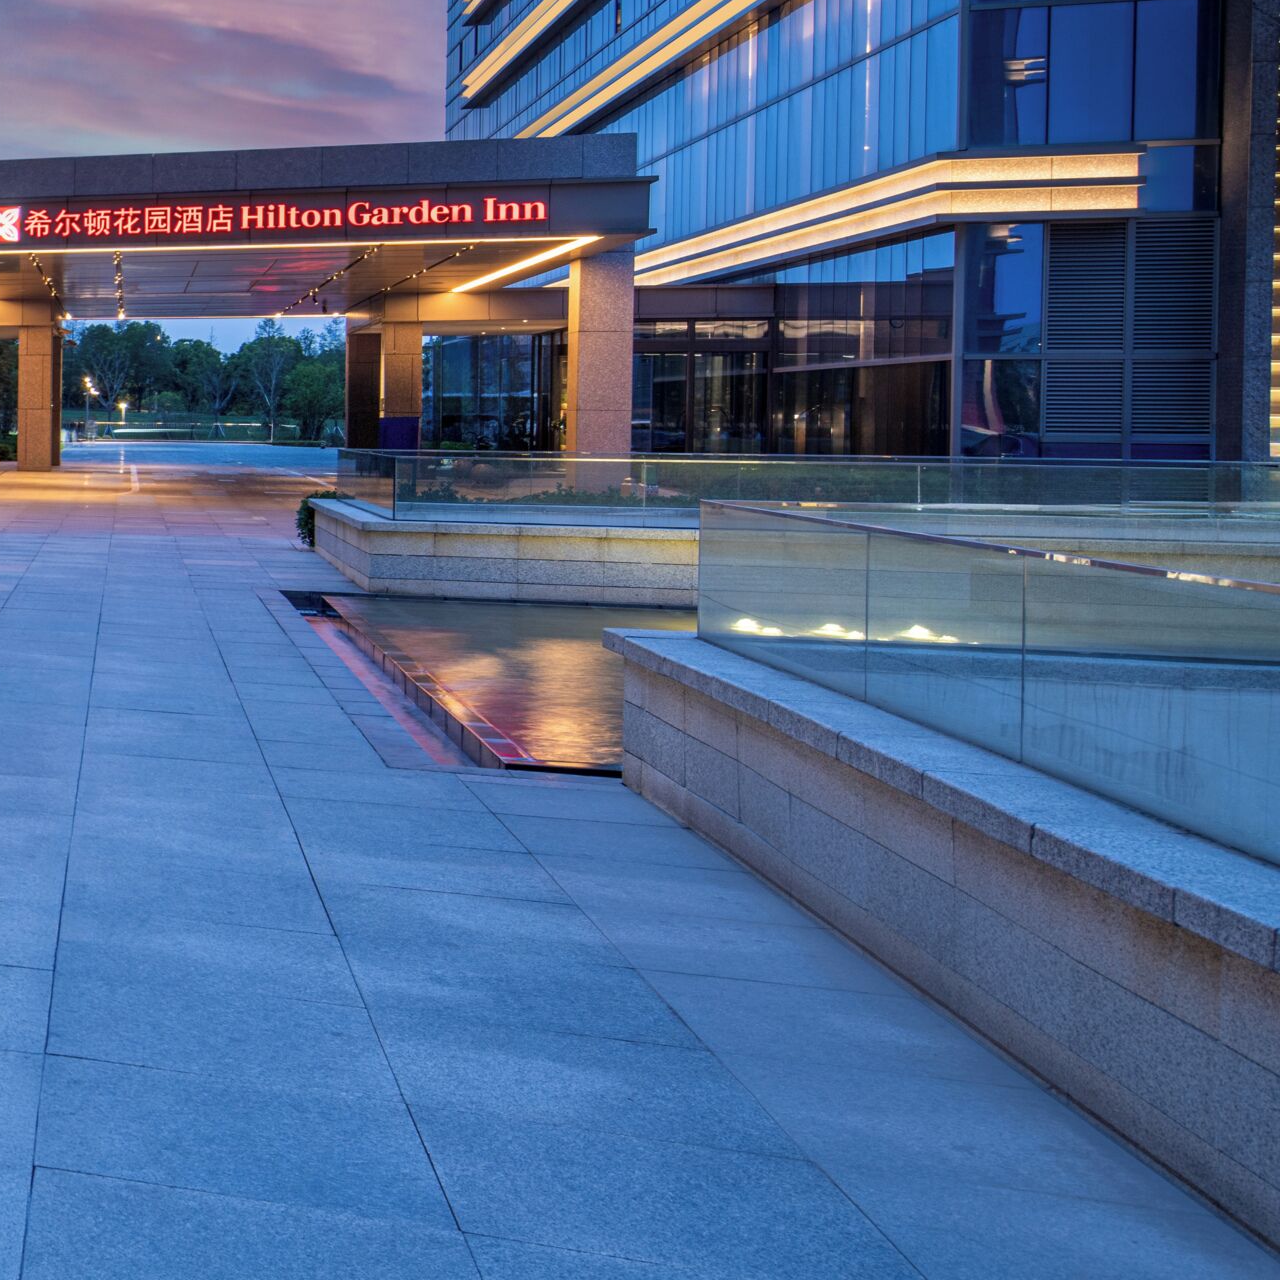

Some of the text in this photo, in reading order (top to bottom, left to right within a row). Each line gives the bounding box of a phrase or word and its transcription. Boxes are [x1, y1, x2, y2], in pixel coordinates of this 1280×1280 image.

[24, 197, 546, 237] 希尔顿花园酒店 Hilton Garden Inn
